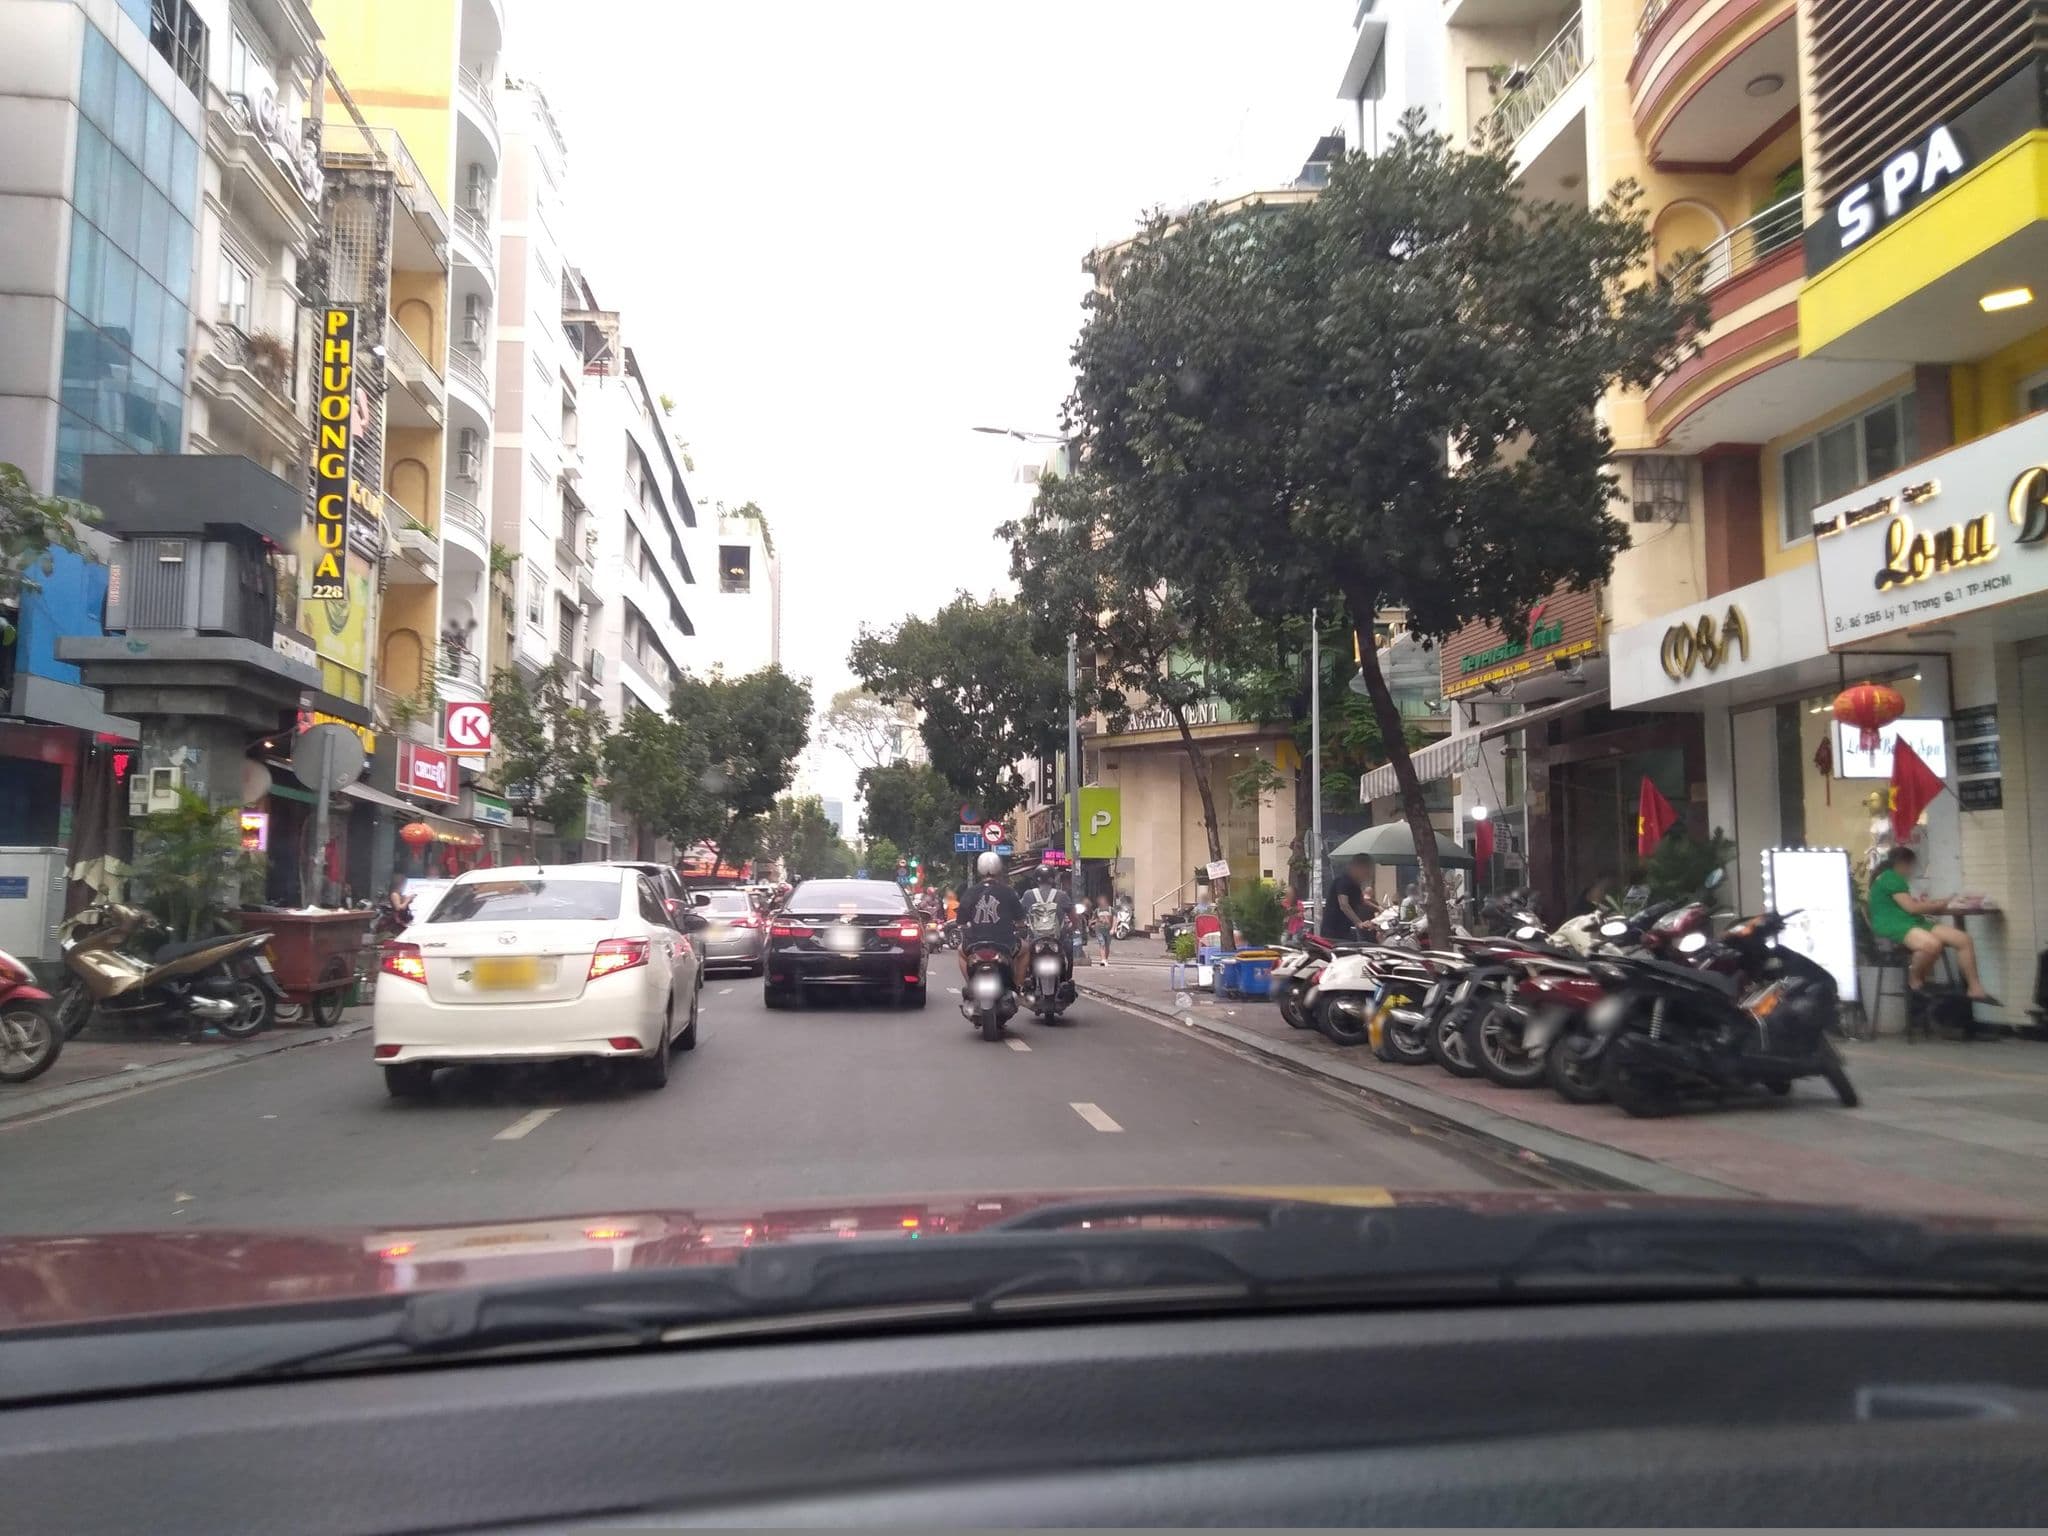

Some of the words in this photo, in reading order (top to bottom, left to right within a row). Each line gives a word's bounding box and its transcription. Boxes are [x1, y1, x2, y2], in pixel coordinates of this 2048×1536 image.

[1838, 125, 1964, 248] SPA
[319, 310, 351, 480] PHƯƠNG
[1874, 513, 2001, 592] Lona
[1864, 610, 1882, 625] 255
[461, 715, 484, 741] K
[1090, 810, 1112, 836] P
